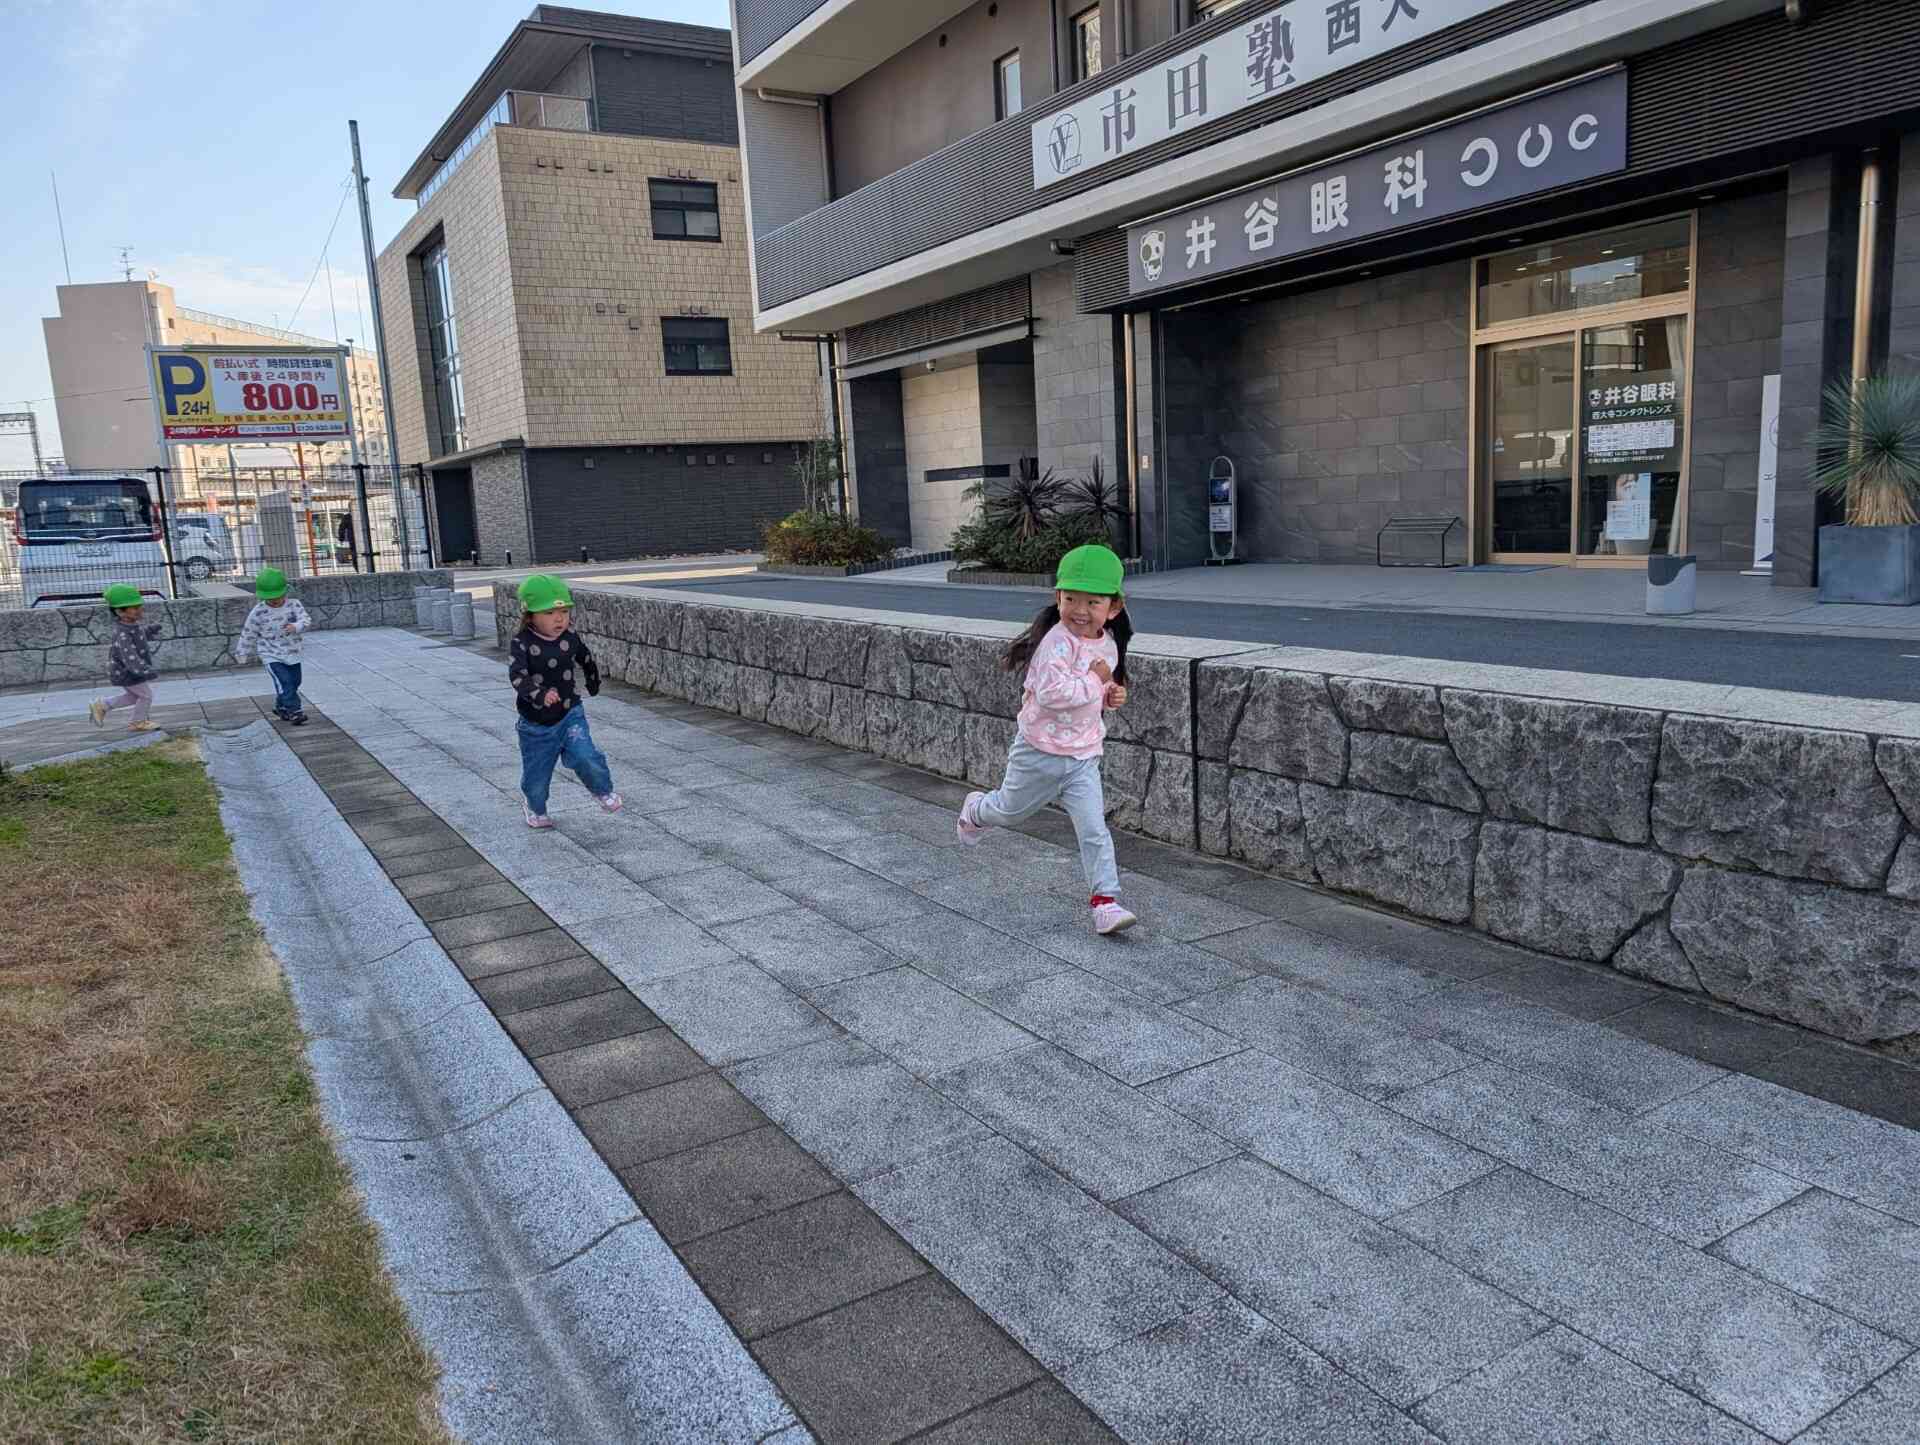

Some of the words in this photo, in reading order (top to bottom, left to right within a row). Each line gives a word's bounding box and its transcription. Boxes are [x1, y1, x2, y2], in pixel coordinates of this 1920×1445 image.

[1099, 14, 1296, 155] 市田塾
[1185, 149, 1429, 269] 井谷眼科
[213, 358, 260, 369] 前払い式
[158, 355, 206, 416] P
[224, 371, 327, 382] 入庫後24時間内
[243, 383, 339, 412] 800円
[1604, 381, 1676, 406] 井谷眼科
[182, 401, 210, 416] 24H
[1591, 404, 1673, 420] 西大寺コンタクトレンズ
